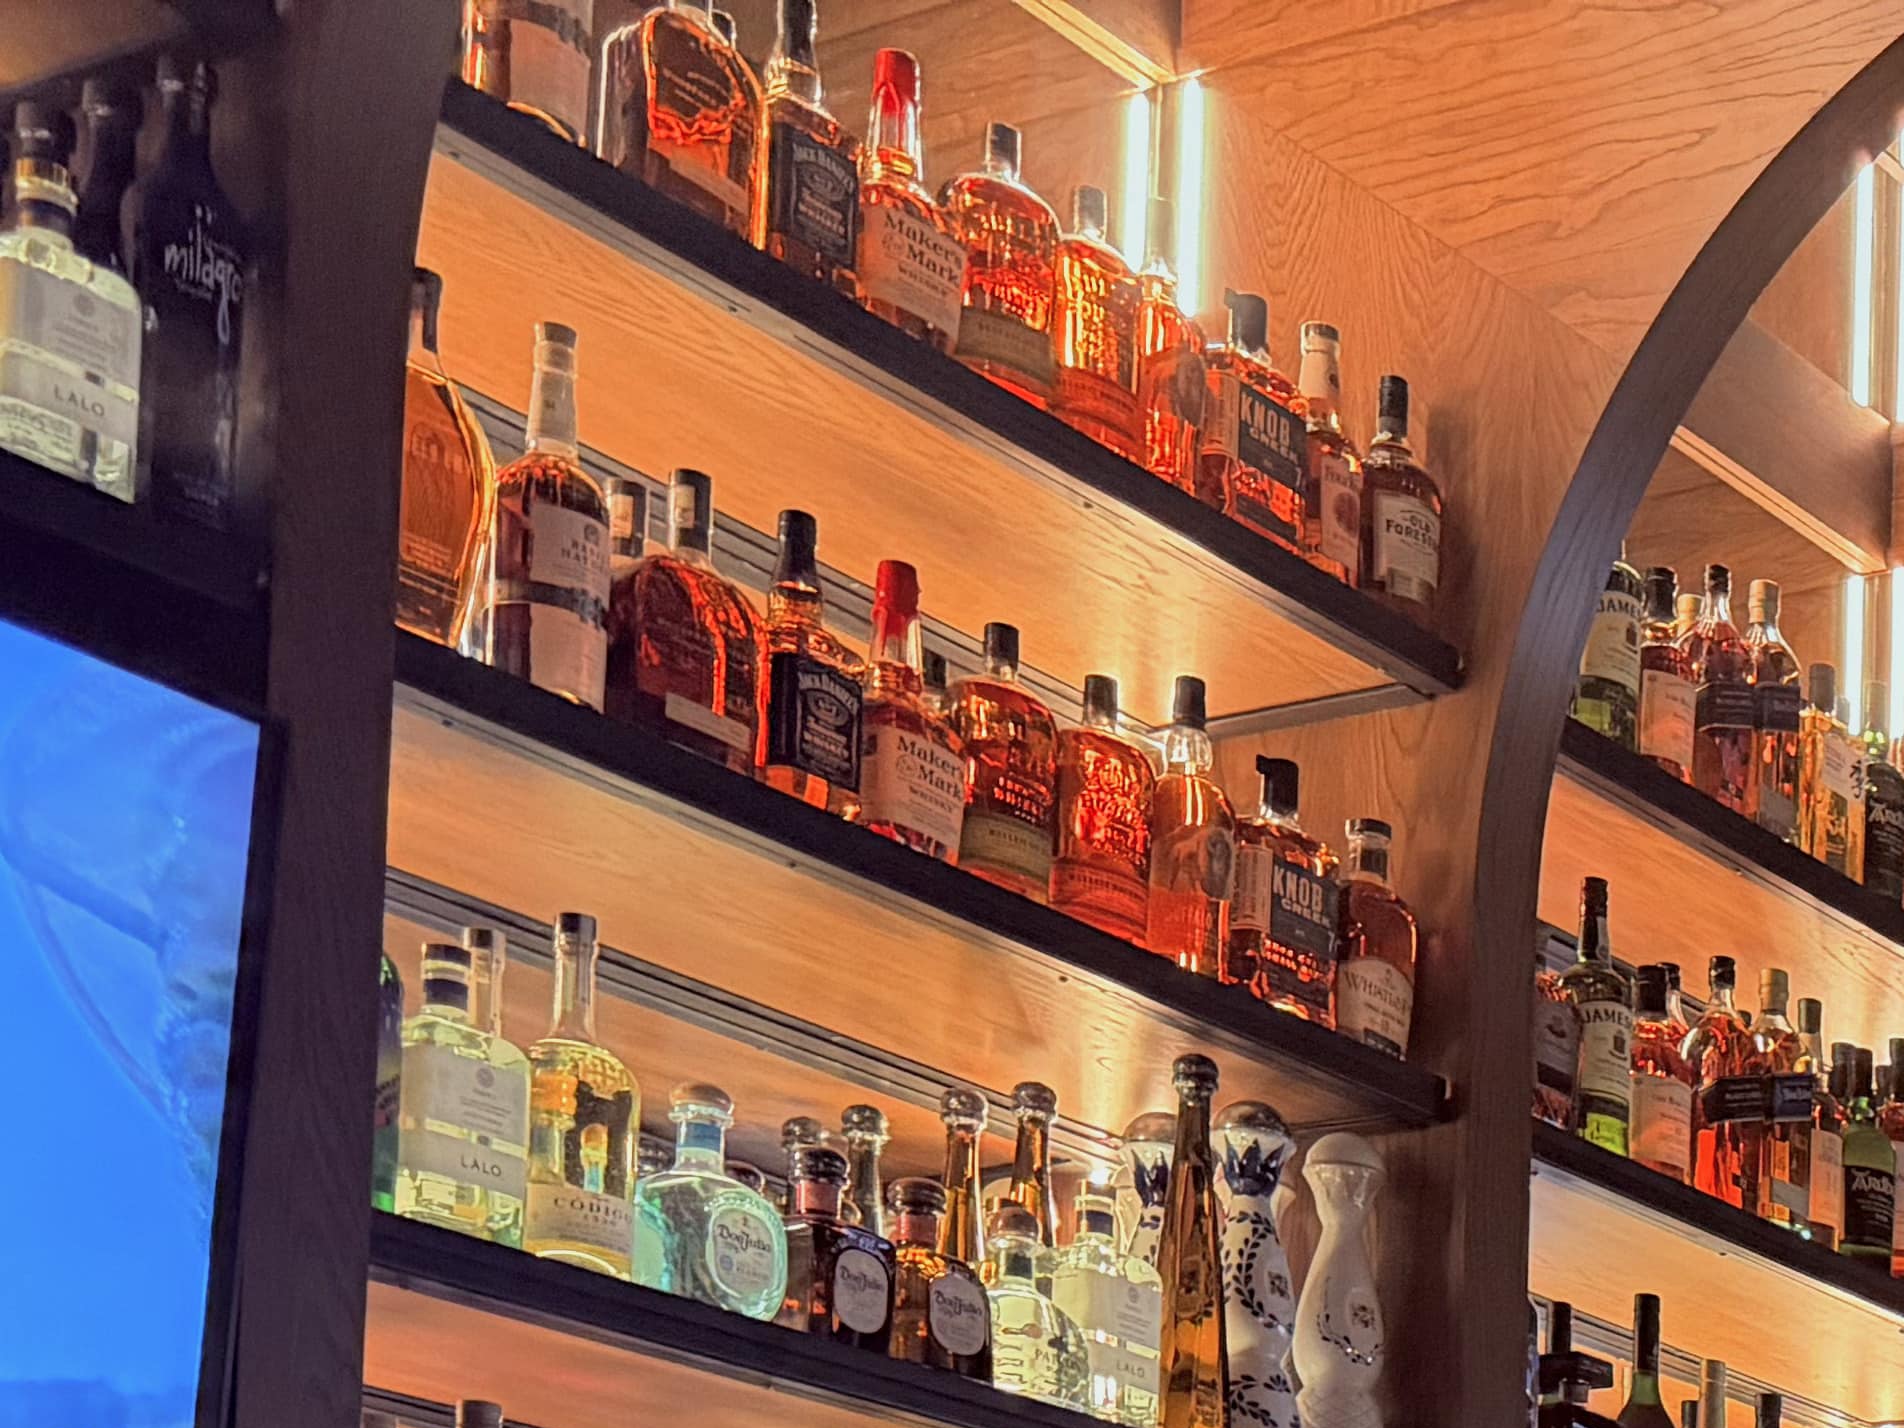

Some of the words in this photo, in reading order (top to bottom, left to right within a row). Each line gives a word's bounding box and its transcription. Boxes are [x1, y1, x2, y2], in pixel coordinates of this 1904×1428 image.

[905, 243, 960, 287] Mark
[53, 384, 105, 417] LALO
[1241, 391, 1292, 442] KNOB
[918, 764, 963, 799] Mark
[1273, 865, 1324, 913] KNOB
[460, 1153, 504, 1178] LALO
[1116, 1359, 1146, 1379] LALO
